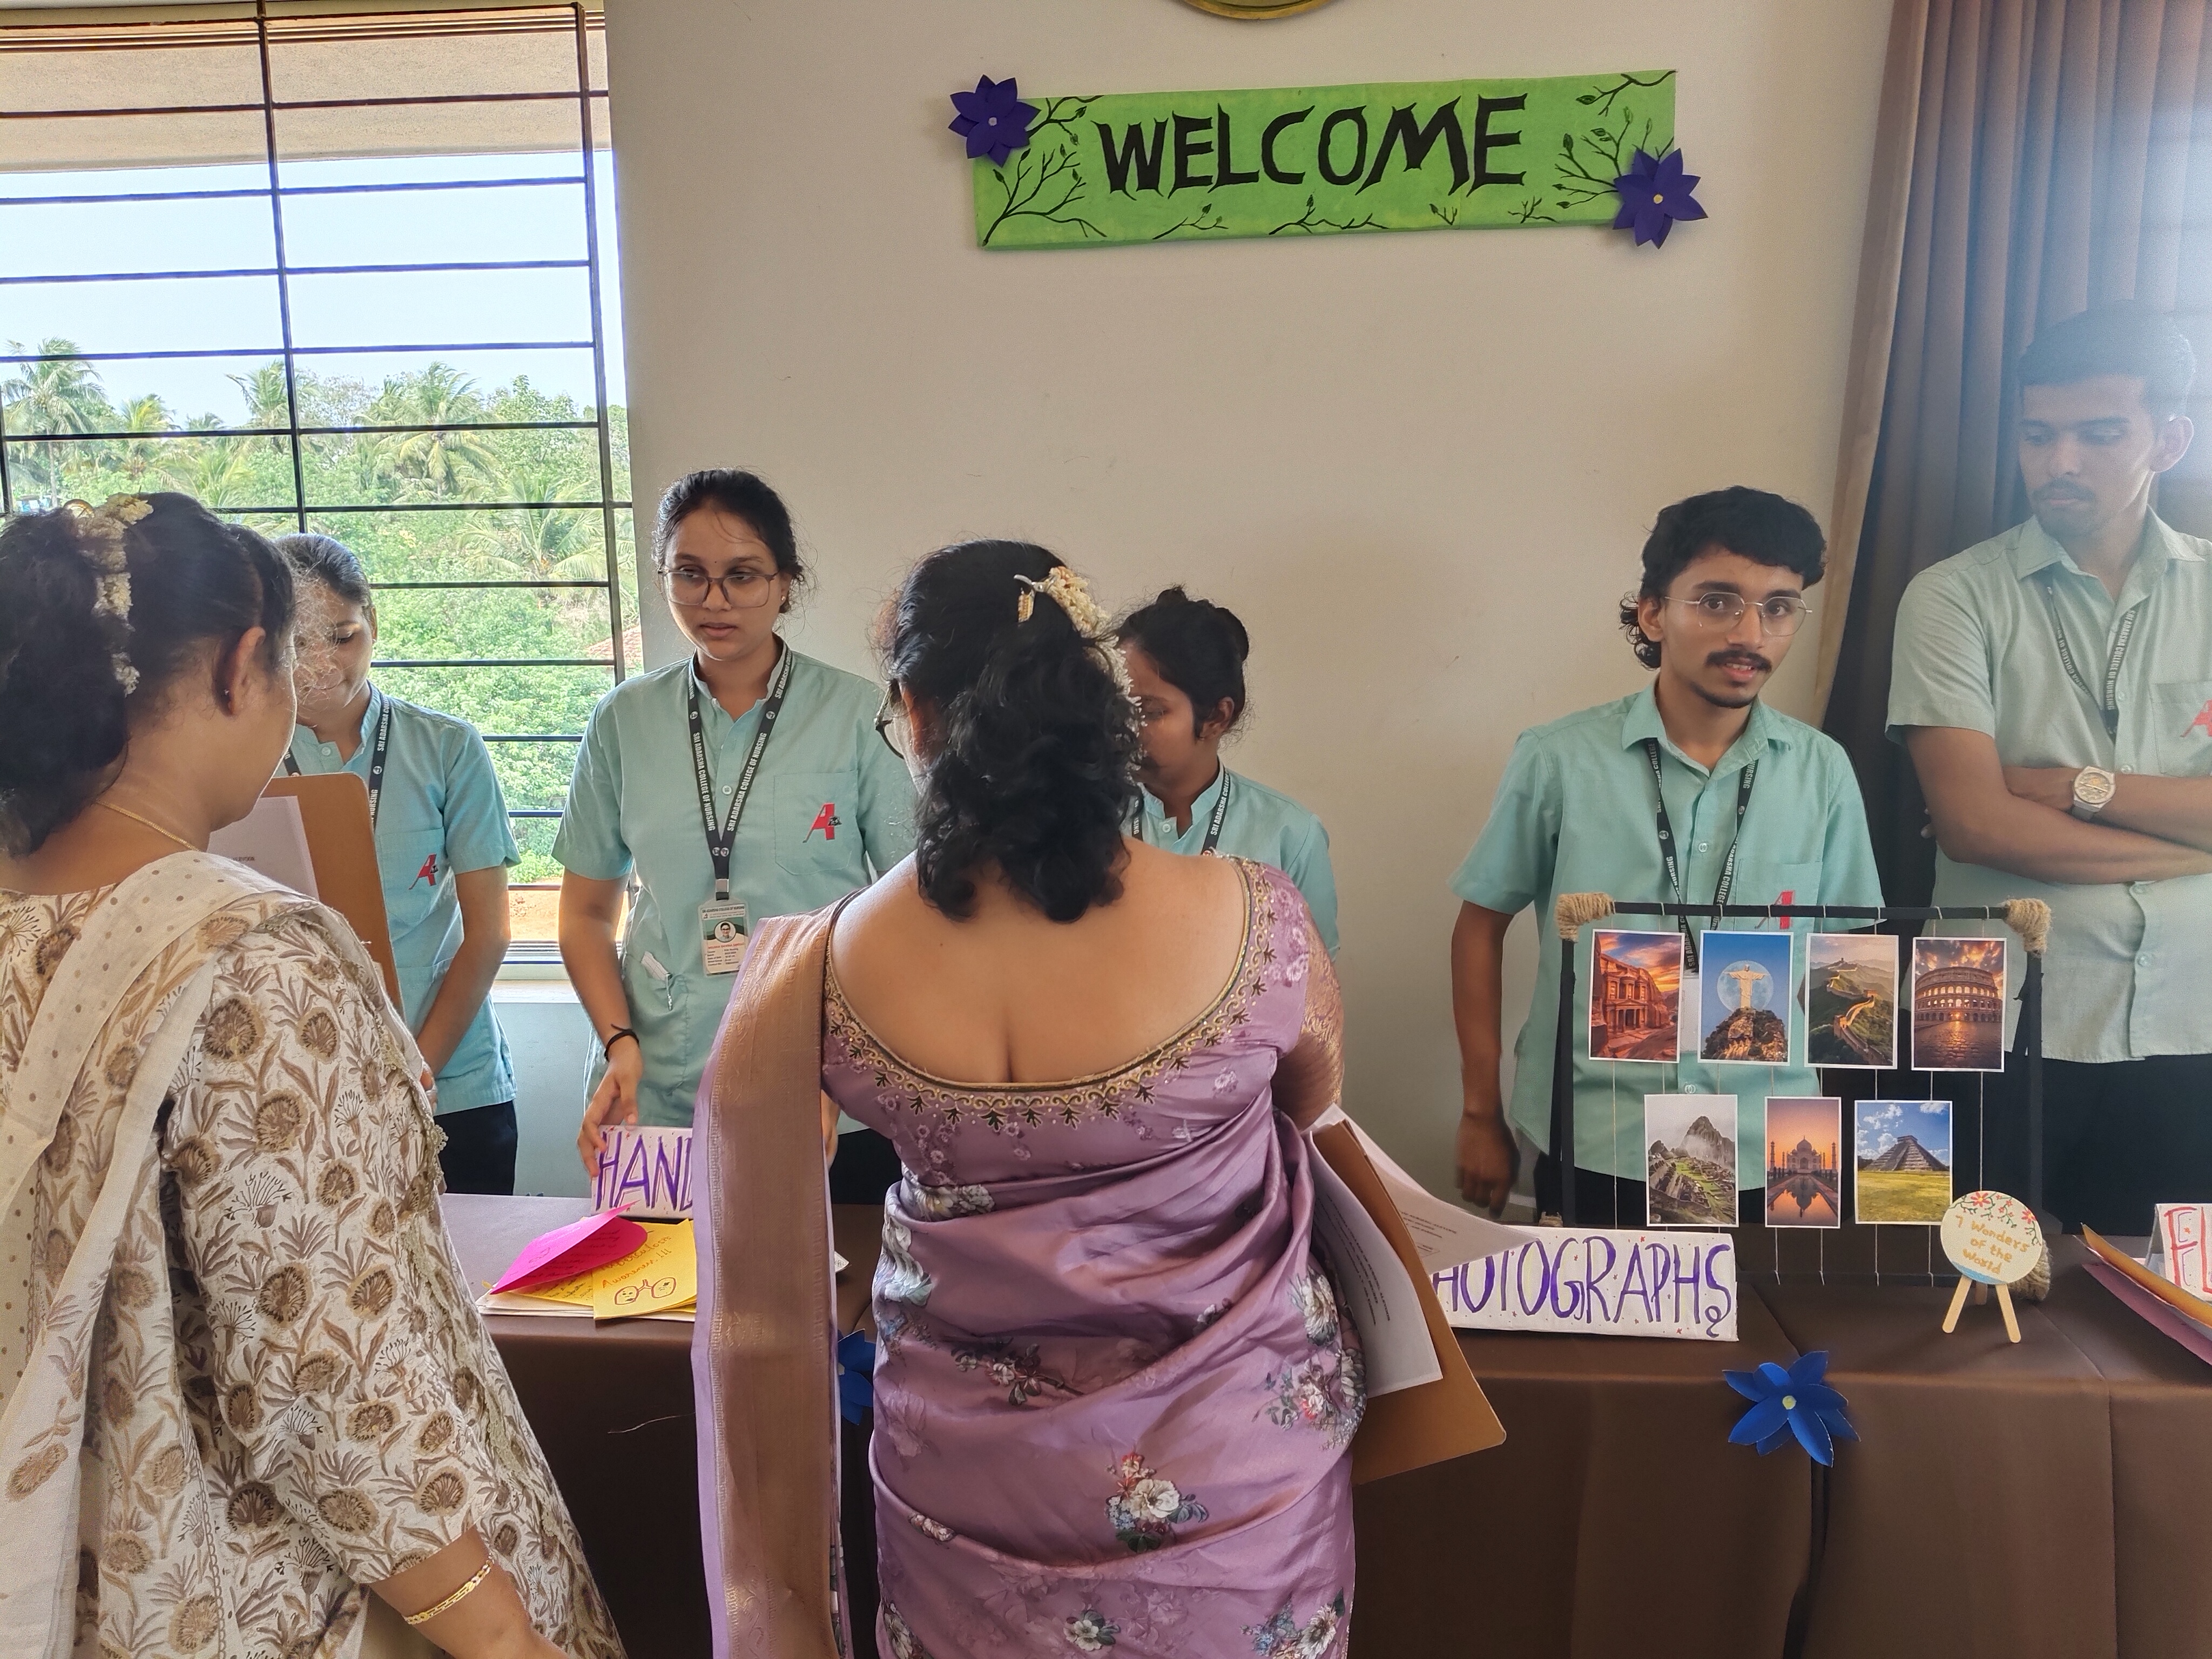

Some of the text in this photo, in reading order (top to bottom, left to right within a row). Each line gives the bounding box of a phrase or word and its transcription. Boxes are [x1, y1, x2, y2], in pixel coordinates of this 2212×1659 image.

[1091, 93, 1528, 200] WELCOME
[379, 713, 389, 741] ADARSHA
[693, 732, 701, 743] SRI
[377, 740, 385, 751] SRI
[694, 743, 705, 770] ADARSHA
[698, 770, 709, 794] COLLEGE
[727, 732, 767, 831] SRI ADARSHA COLLEGE OF NURSING
[704, 802, 716, 831] NURSING
[1213, 796, 1227, 824] ADARSHA
[1210, 824, 1219, 835] SRI
[1666, 856, 1678, 886] NURSING
[1717, 876, 1730, 904] COLLEGE
[1687, 955, 1695, 967] SRI
[1955, 1215, 2030, 1252] 7 Wonders
[1970, 1238, 2012, 1263] of the
[1433, 1236, 1731, 1338] HOTOGRAPHS
